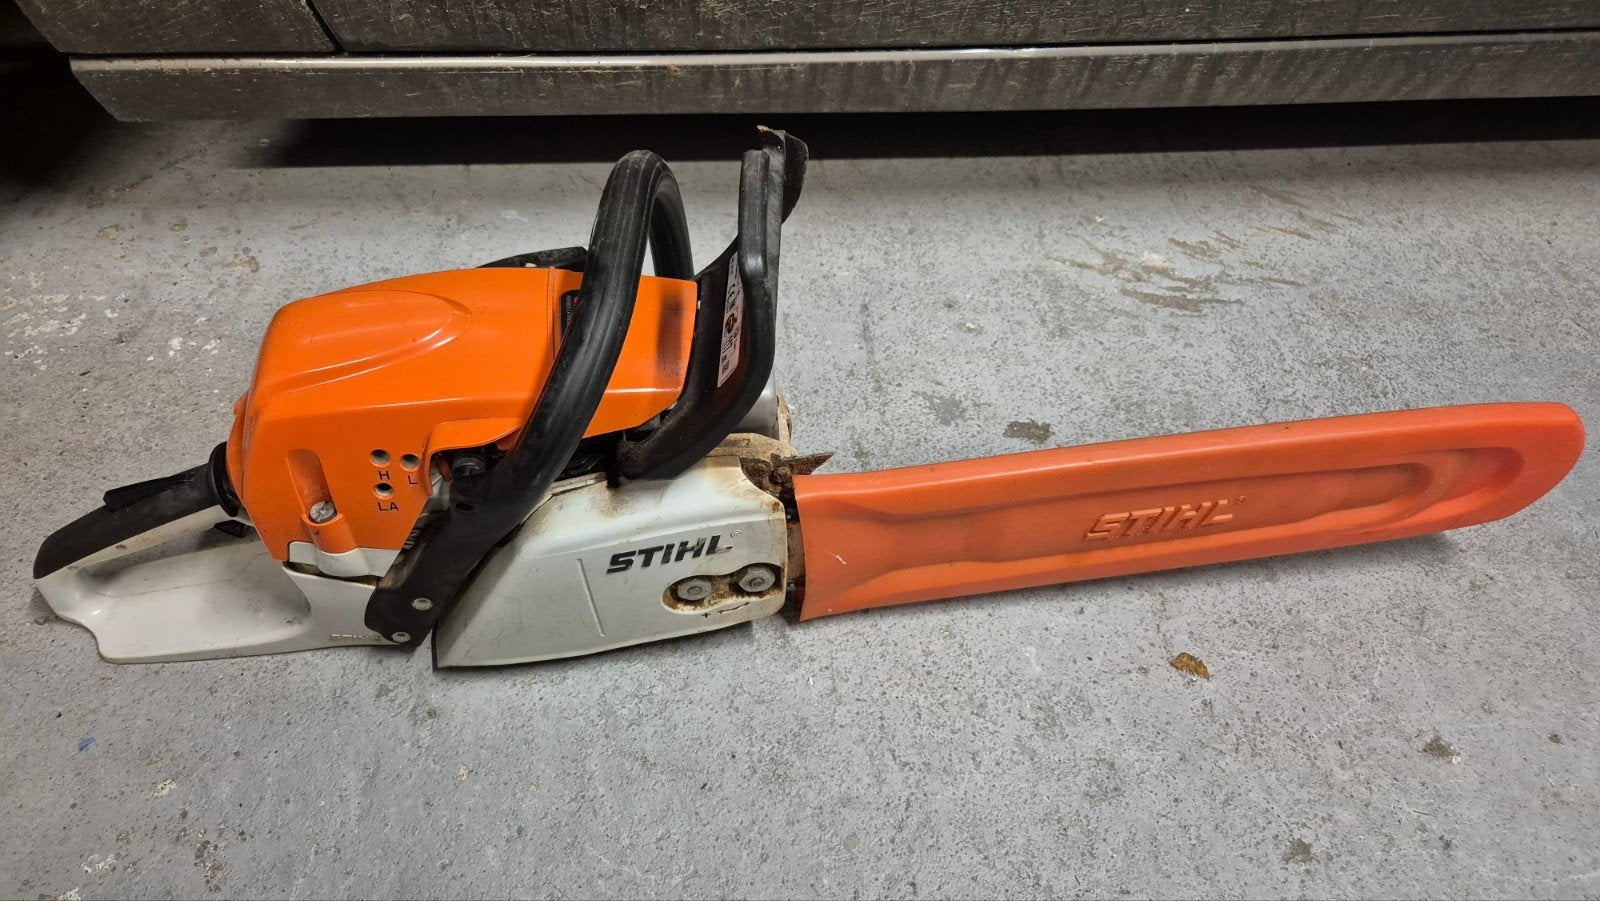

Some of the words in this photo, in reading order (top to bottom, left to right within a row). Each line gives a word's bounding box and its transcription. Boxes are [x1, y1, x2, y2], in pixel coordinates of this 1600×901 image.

[379, 470, 390, 480] H
[407, 474, 419, 485] L
[377, 501, 399, 511] LA
[1083, 498, 1234, 541] STIHL
[606, 534, 733, 574] STIHL
